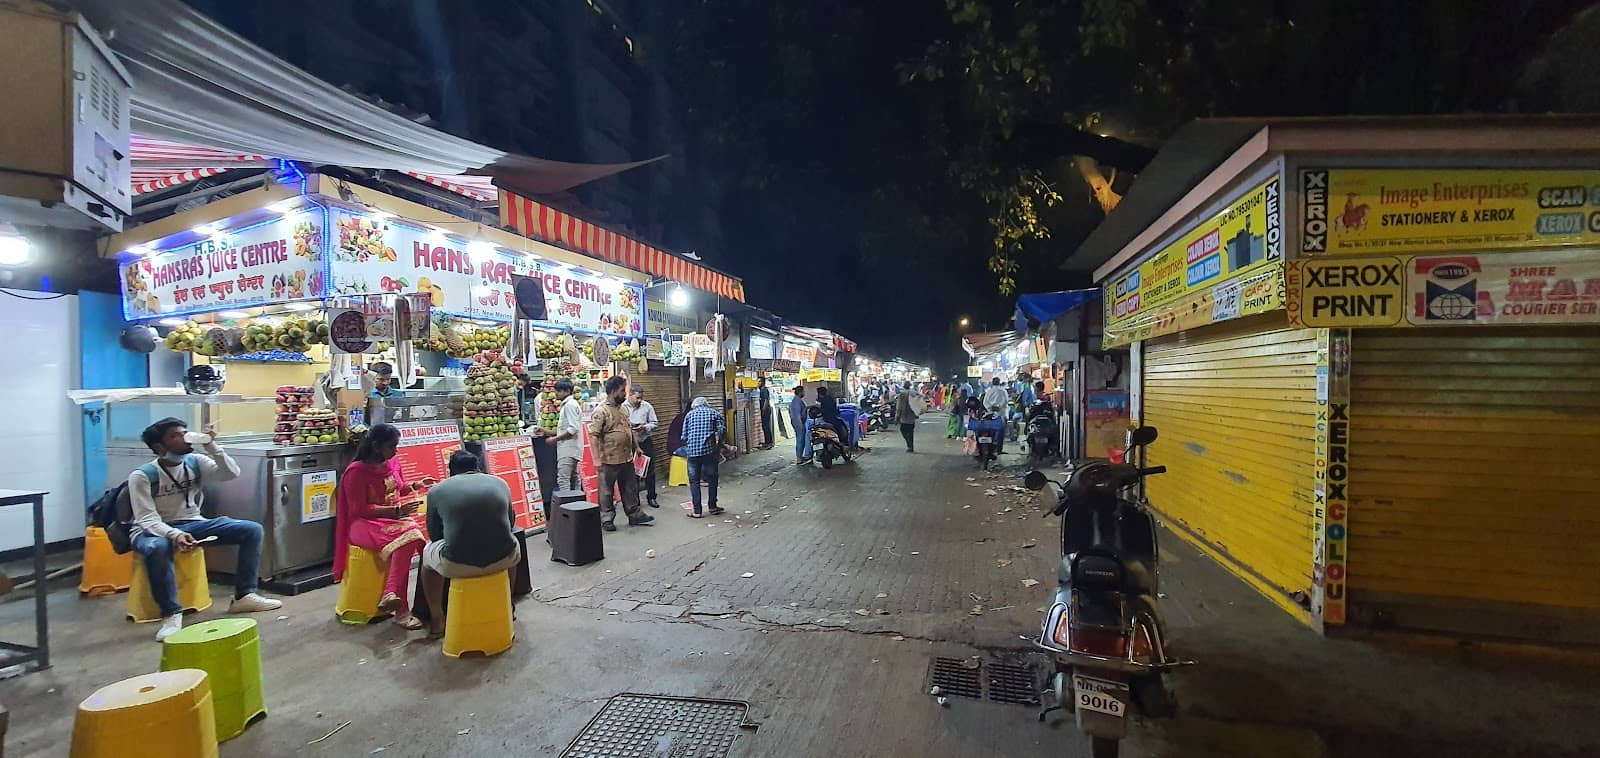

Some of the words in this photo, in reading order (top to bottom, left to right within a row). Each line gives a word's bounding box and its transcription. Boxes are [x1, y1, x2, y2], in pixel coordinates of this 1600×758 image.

[1380, 185, 1427, 209] Image
[1433, 181, 1529, 205] Enterprises
[1541, 188, 1584, 207] SCAN
[1266, 182, 1280, 260] XEROX
[1304, 172, 1328, 250] XEROX
[1381, 211, 1455, 227] STATIONERY
[1460, 211, 1469, 223] &
[1474, 208, 1515, 222] XEROX
[1539, 215, 1582, 233] XEROX
[152, 255, 205, 289] HANSRAS
[206, 248, 238, 279] JUICE
[241, 239, 288, 267] CENTRE
[413, 241, 474, 276] HANS
[564, 278, 612, 305] CENTRE
[1305, 263, 1401, 288] XEROX
[1509, 266, 1557, 278] SHREE
[1243, 294, 1273, 310] PRINT
[1286, 260, 1300, 326] XEROX
[1312, 294, 1394, 317] PRINT
[1502, 303, 1567, 316] COURIER
[1328, 403, 1348, 500] XEROX
[1080, 694, 1119, 713] 9016
